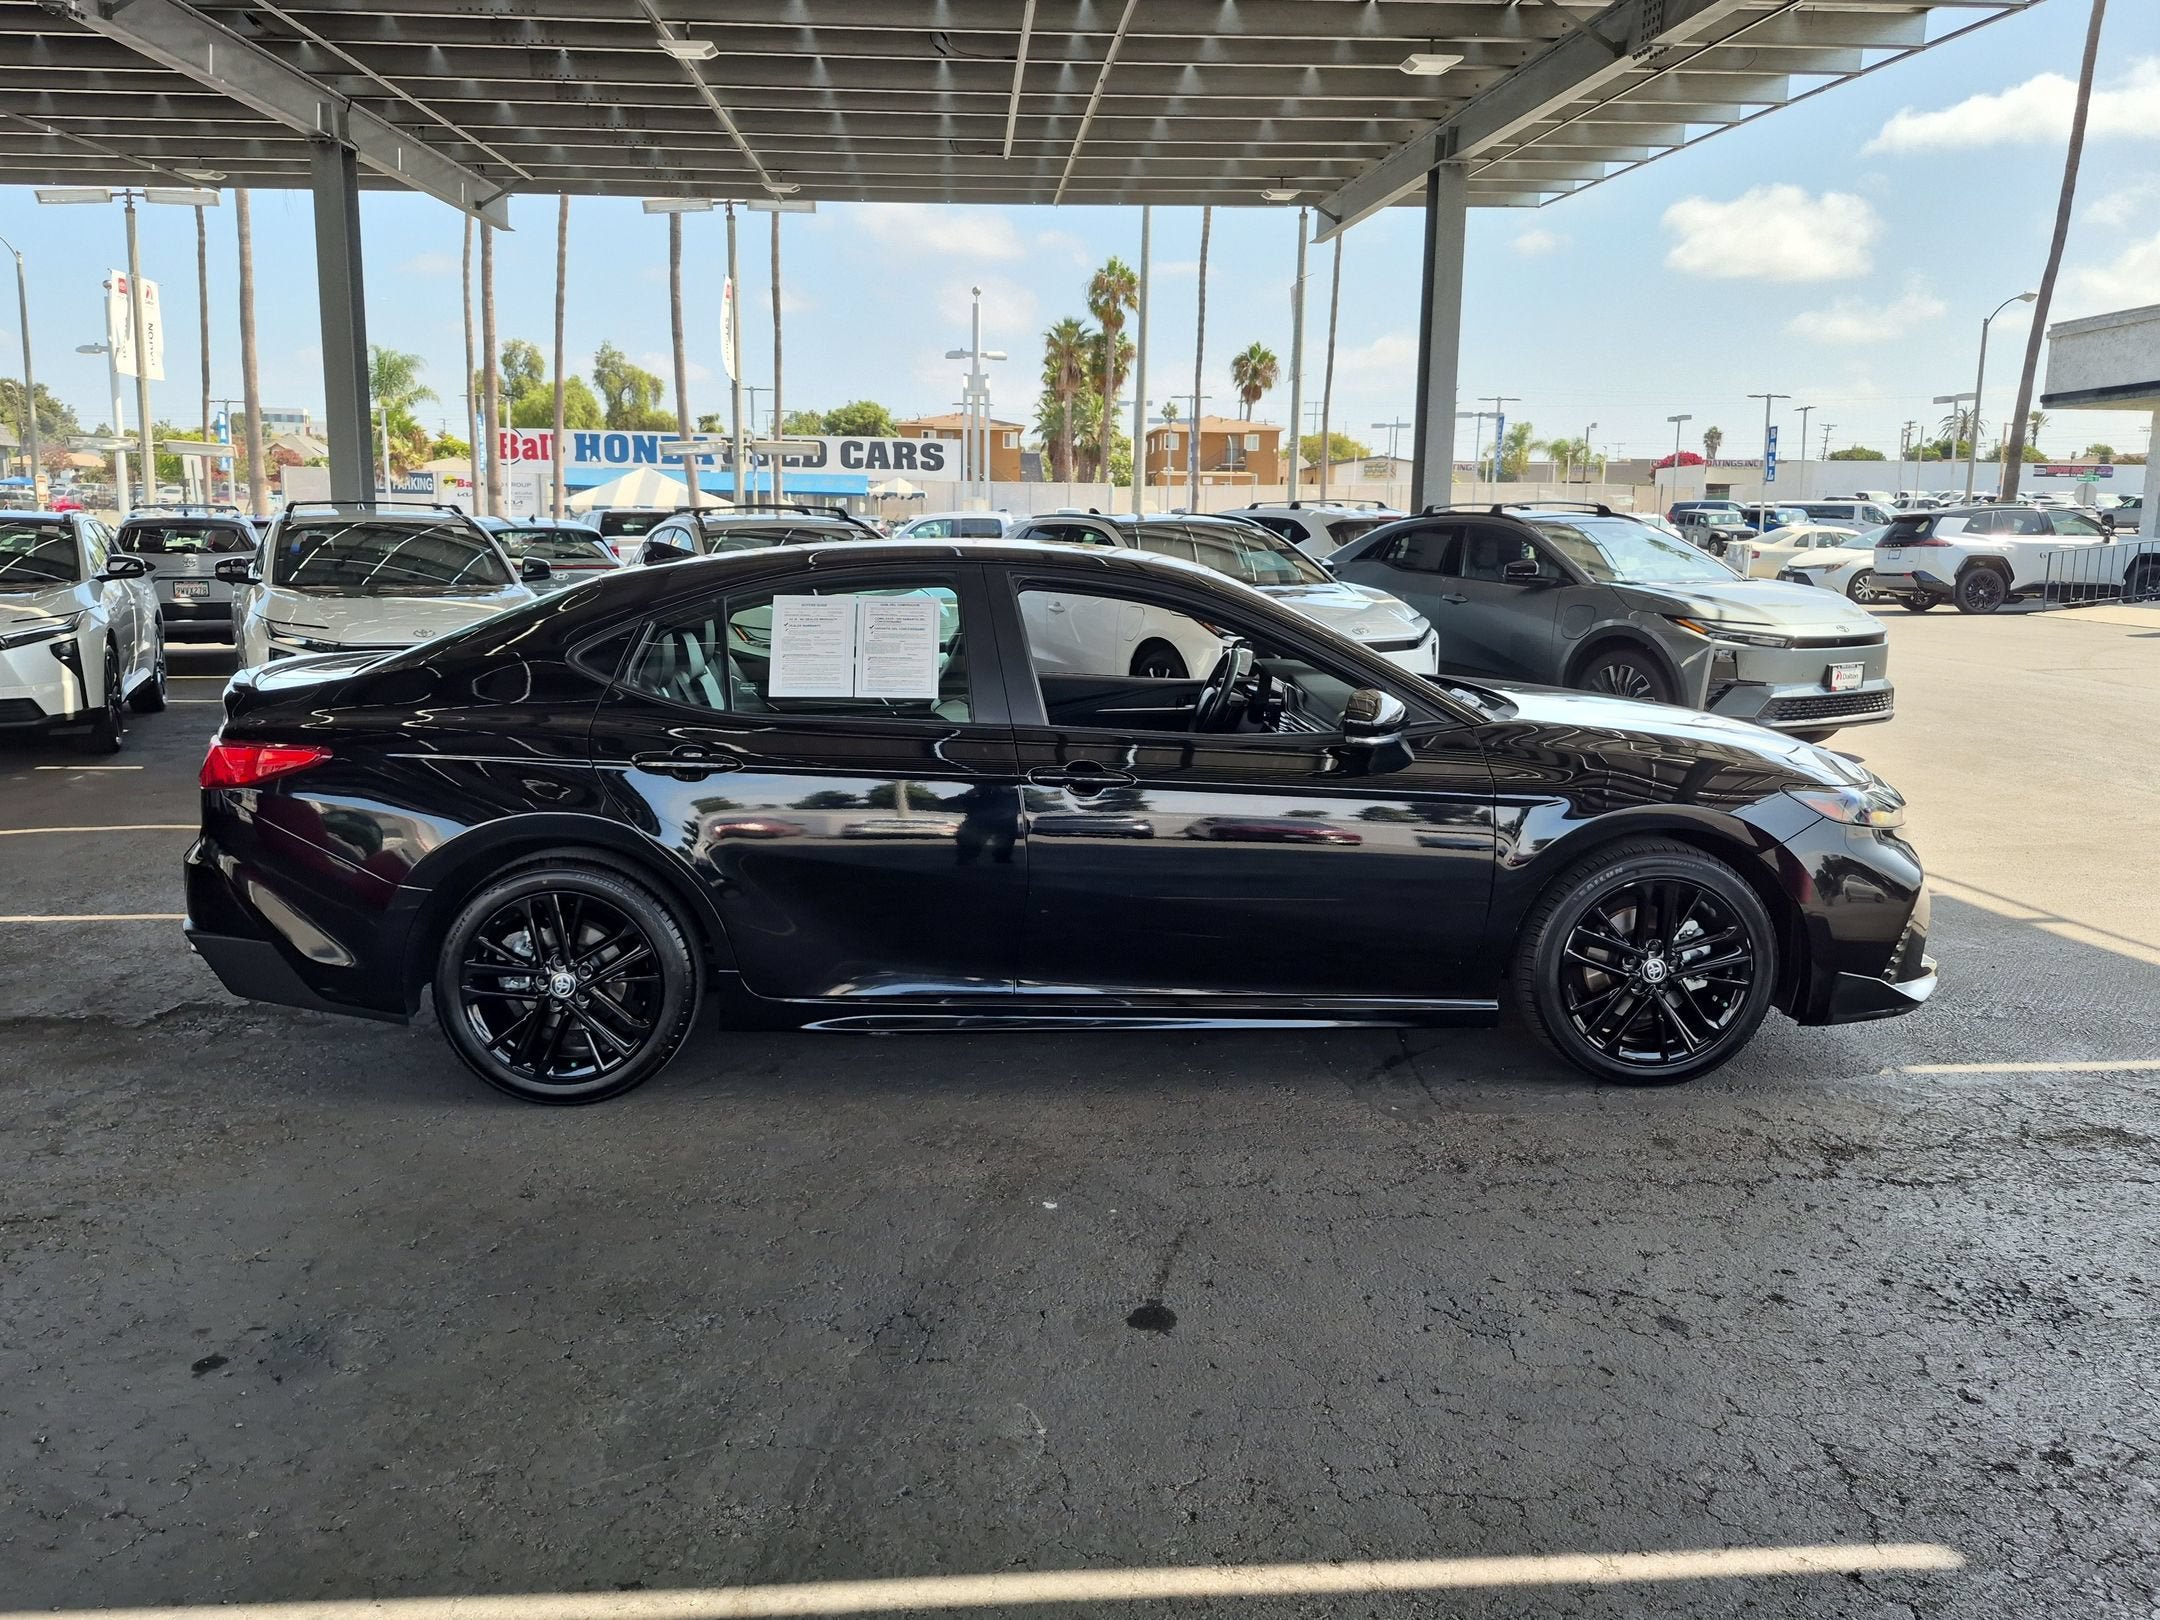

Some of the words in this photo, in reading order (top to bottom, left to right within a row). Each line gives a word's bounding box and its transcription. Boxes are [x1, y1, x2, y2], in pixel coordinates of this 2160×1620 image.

[840, 440, 945, 471] CARS
[1767, 428, 1777, 481] BALL
[1842, 672, 1859, 680] Dalton
